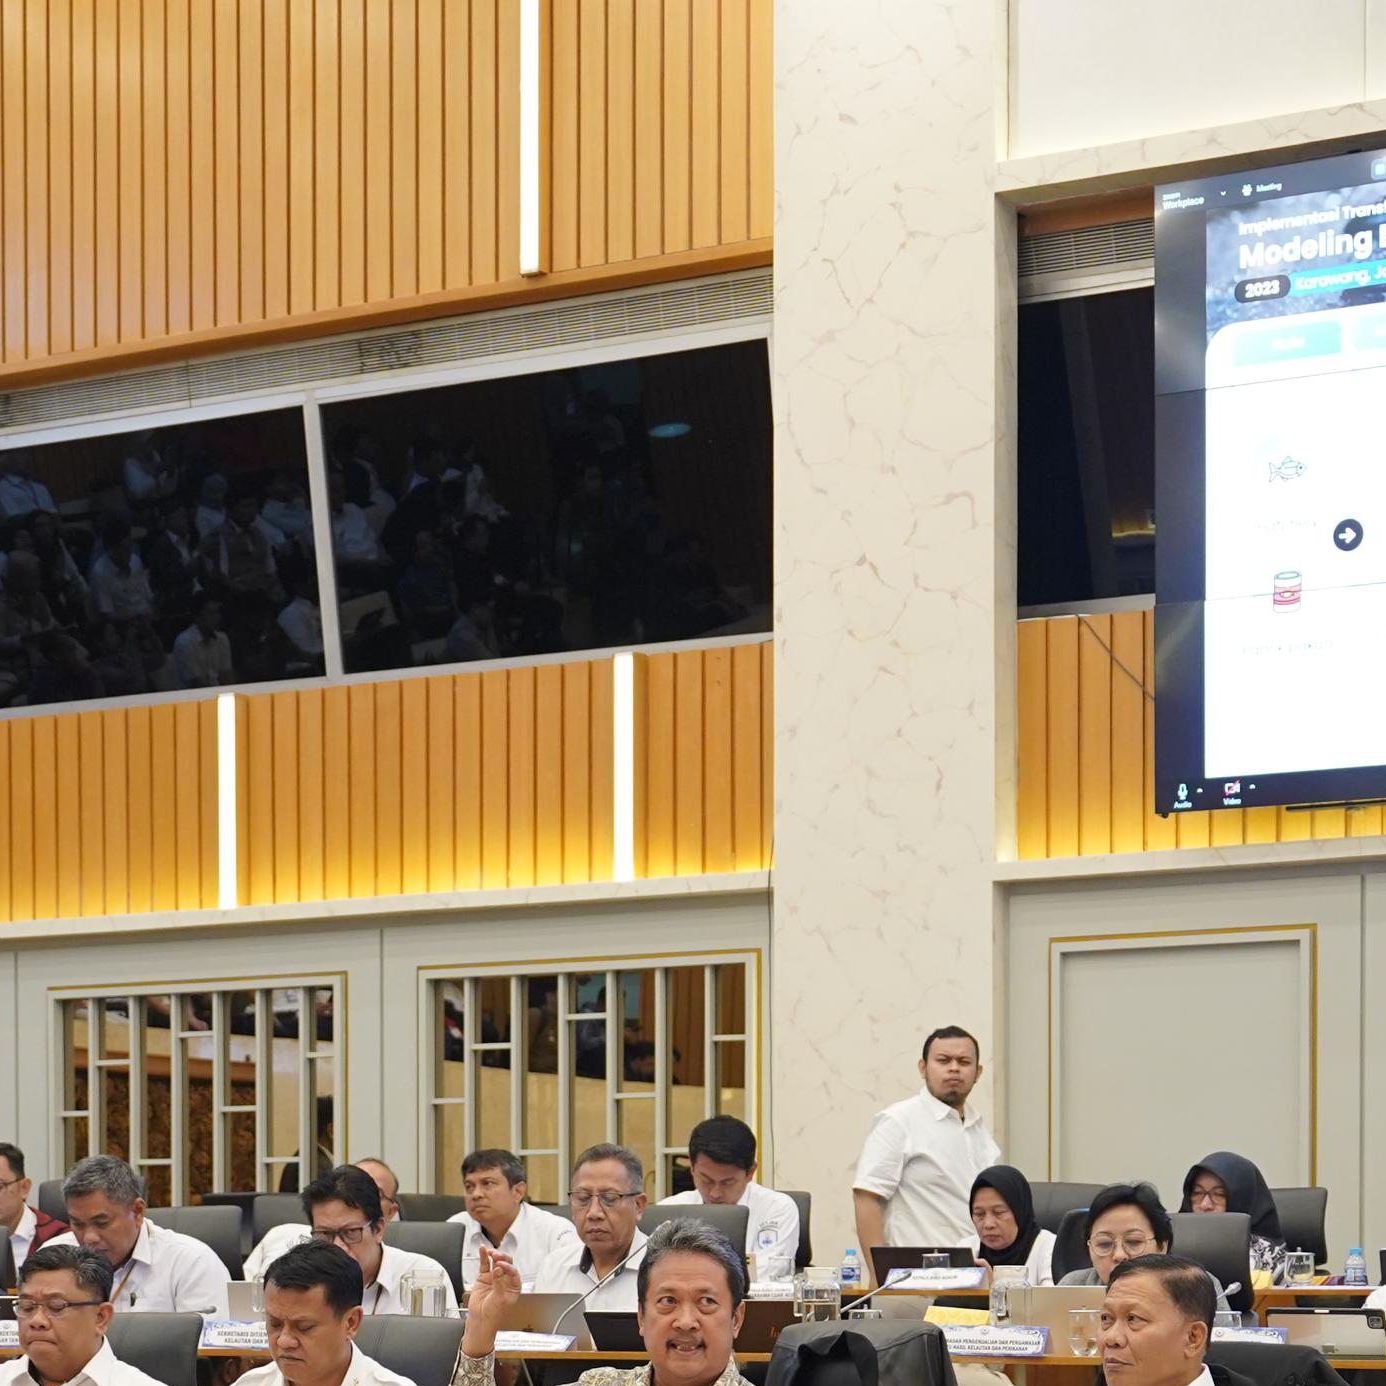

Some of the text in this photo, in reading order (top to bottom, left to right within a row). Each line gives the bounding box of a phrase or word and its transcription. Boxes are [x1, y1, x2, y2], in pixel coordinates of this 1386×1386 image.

[1162, 196, 1204, 210] Workplace
[1238, 208, 1340, 237] Implementasi
[1239, 230, 1372, 269] Modeling
[1295, 266, 1371, 290] Karawang,
[1245, 280, 1280, 299] 2023
[1173, 800, 1192, 809] Audio
[1223, 797, 1242, 806] Video
